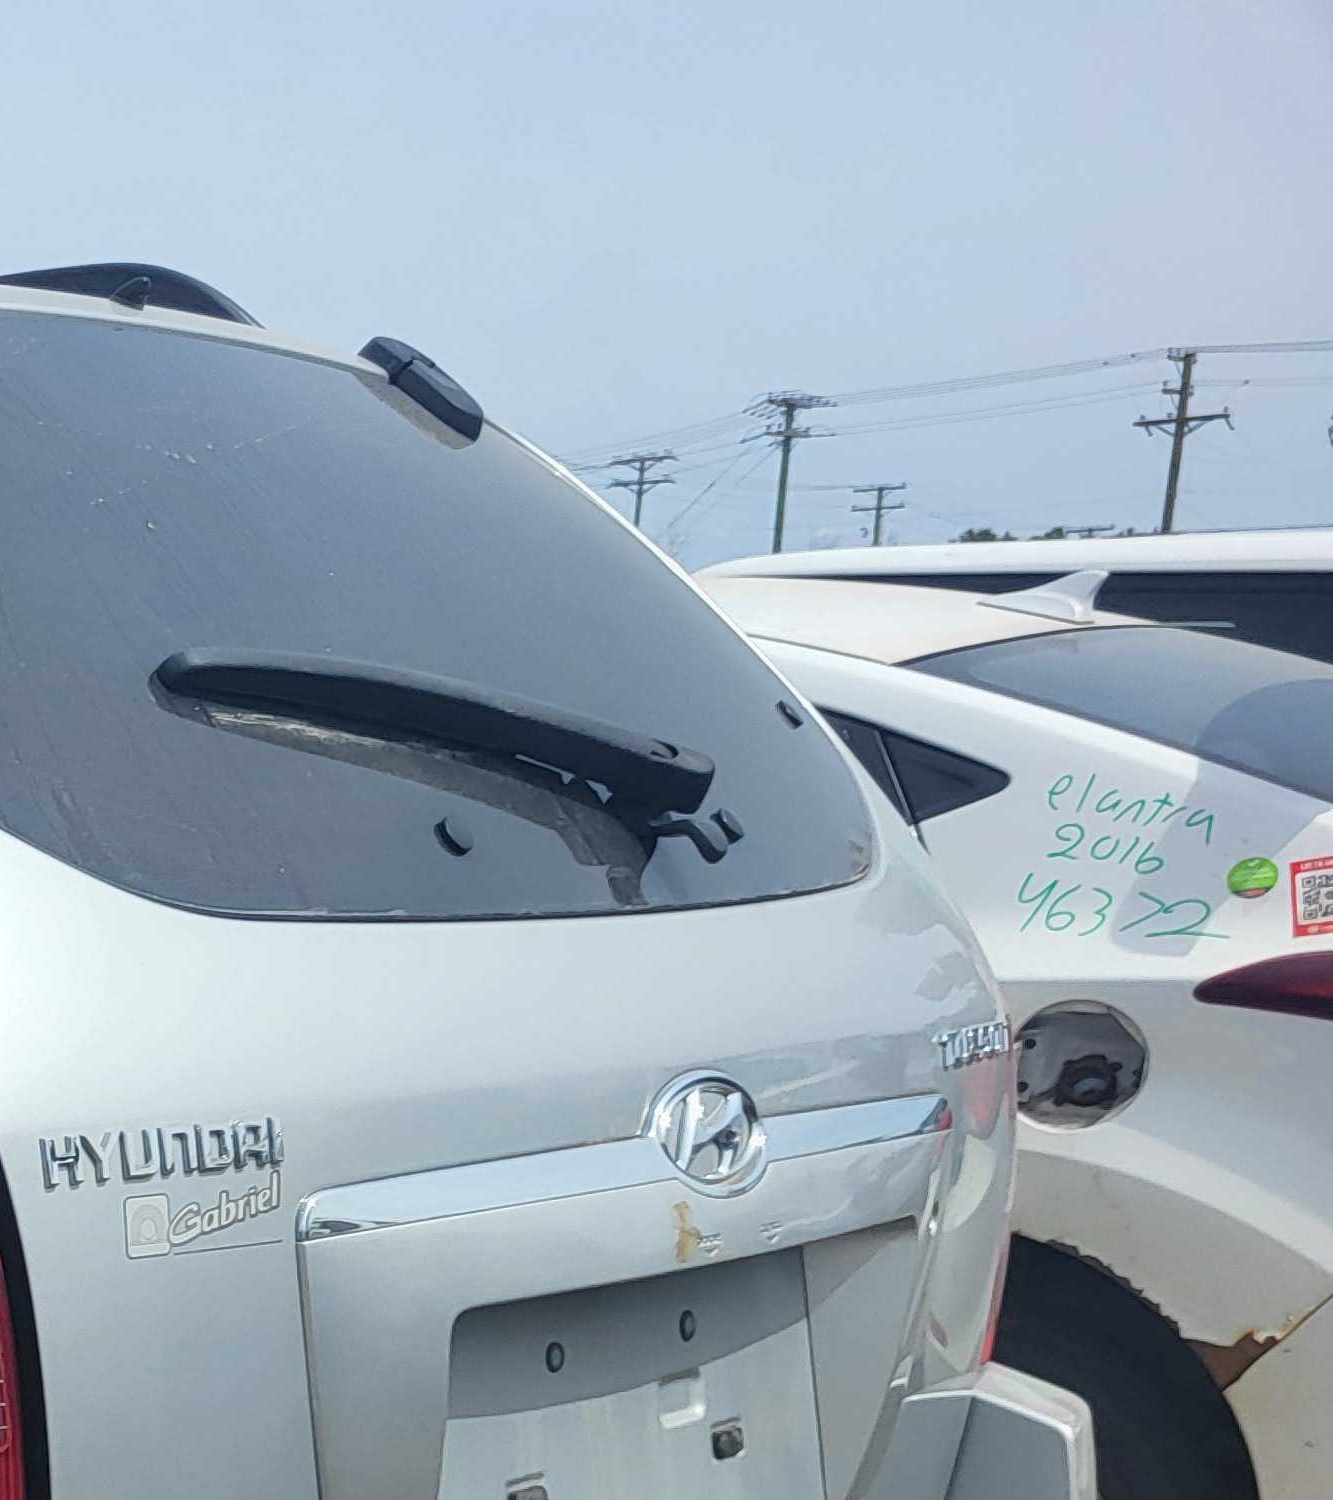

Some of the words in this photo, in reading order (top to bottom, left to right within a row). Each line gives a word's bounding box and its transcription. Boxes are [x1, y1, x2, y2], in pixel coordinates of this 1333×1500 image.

[1046, 773, 1215, 845] elantra
[1046, 823, 1165, 875] 2016
[1017, 872, 1231, 939] 46372
[38, 1116, 285, 1190] HYUNDAI
[168, 1169, 281, 1246] Gabriel
